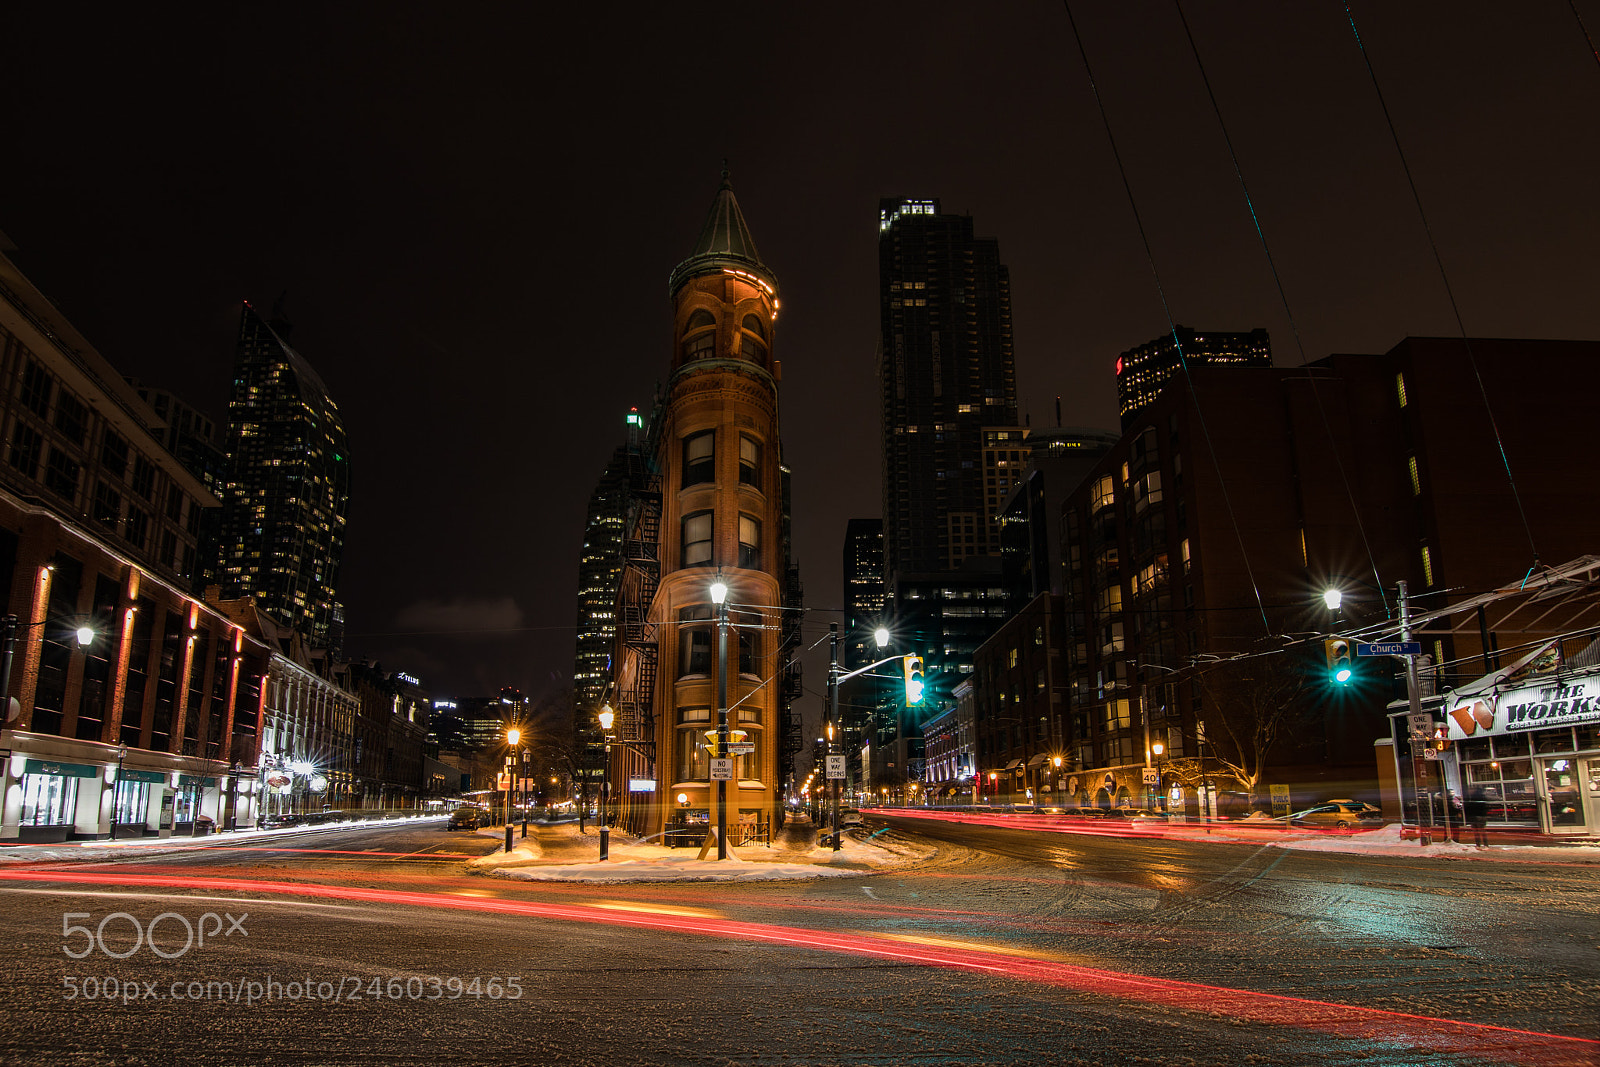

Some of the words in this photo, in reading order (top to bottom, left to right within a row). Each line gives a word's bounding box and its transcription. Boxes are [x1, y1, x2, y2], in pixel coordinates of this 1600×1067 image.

[1370, 643, 1402, 653] Church
[1540, 684, 1585, 702] THE
[1143, 774, 1156, 782] 40
